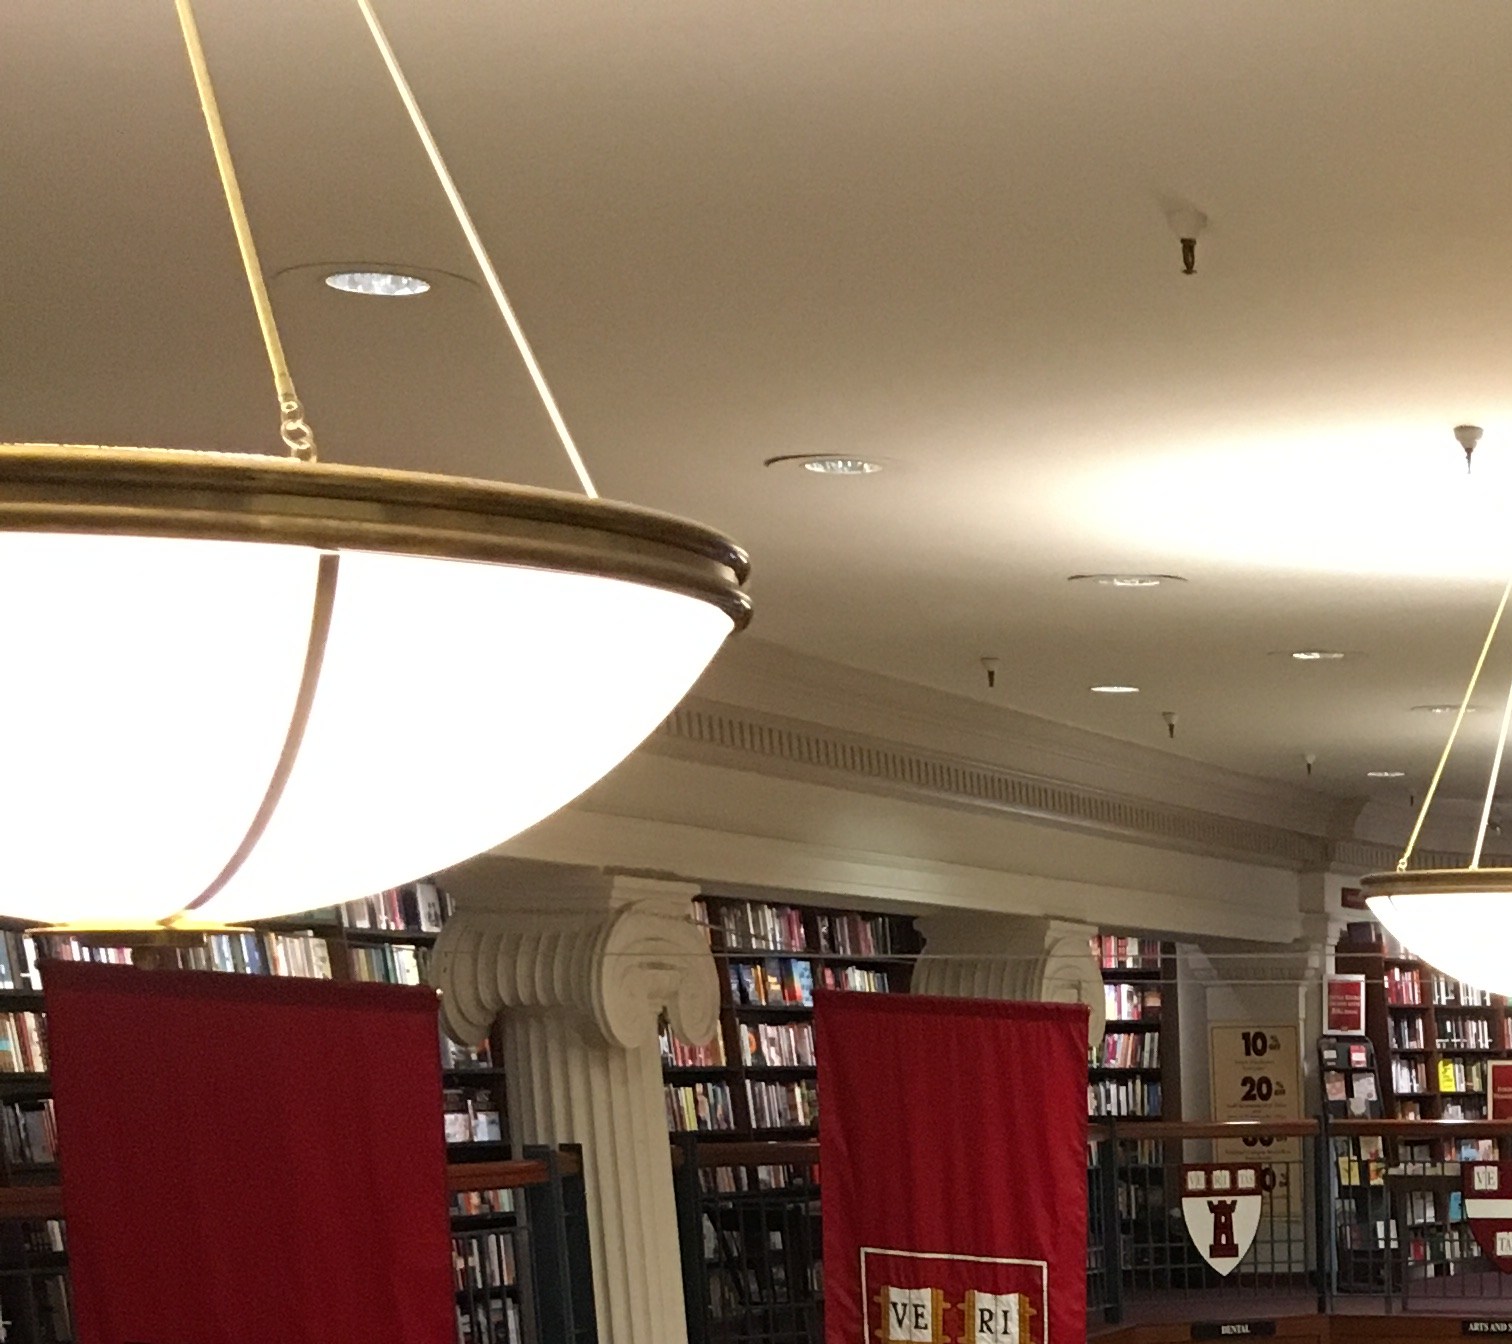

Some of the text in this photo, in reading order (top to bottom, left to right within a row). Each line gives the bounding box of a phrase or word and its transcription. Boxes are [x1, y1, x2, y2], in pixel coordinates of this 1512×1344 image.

[1242, 1032, 1268, 1056] 10
[1241, 1076, 1272, 1101] 20
[1475, 1169, 1497, 1187] VE
[891, 1302, 1011, 1336] VE RI
[1221, 1323, 1251, 1335] DENTAL
